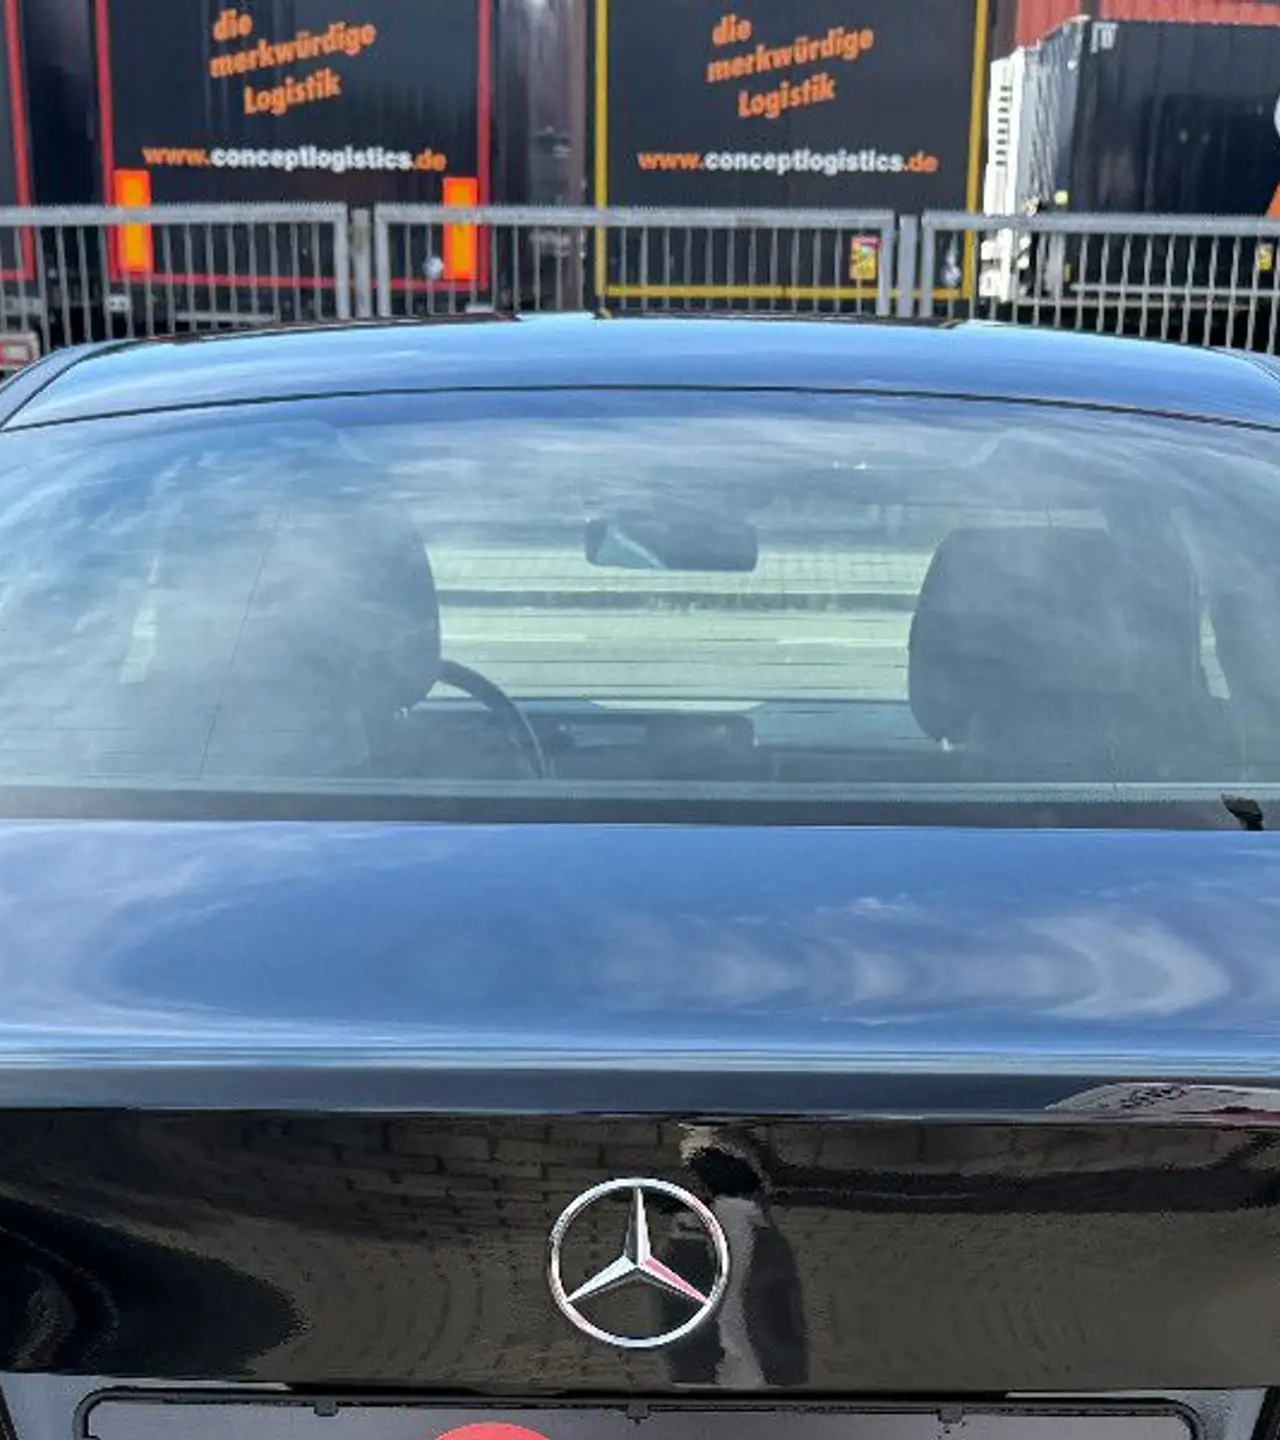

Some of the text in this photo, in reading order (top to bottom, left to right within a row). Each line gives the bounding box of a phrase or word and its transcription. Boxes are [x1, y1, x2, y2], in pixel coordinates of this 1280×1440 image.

[213, 8, 253, 41] die
[712, 13, 753, 46] die
[209, 21, 377, 78] merkwürdige
[706, 27, 875, 82] merkwürdige
[243, 66, 342, 116] Logistik
[737, 72, 836, 118] Logistik
[142, 145, 447, 172] www.conceptlogistics.de
[638, 148, 939, 175] www.conceptlogistics.de
